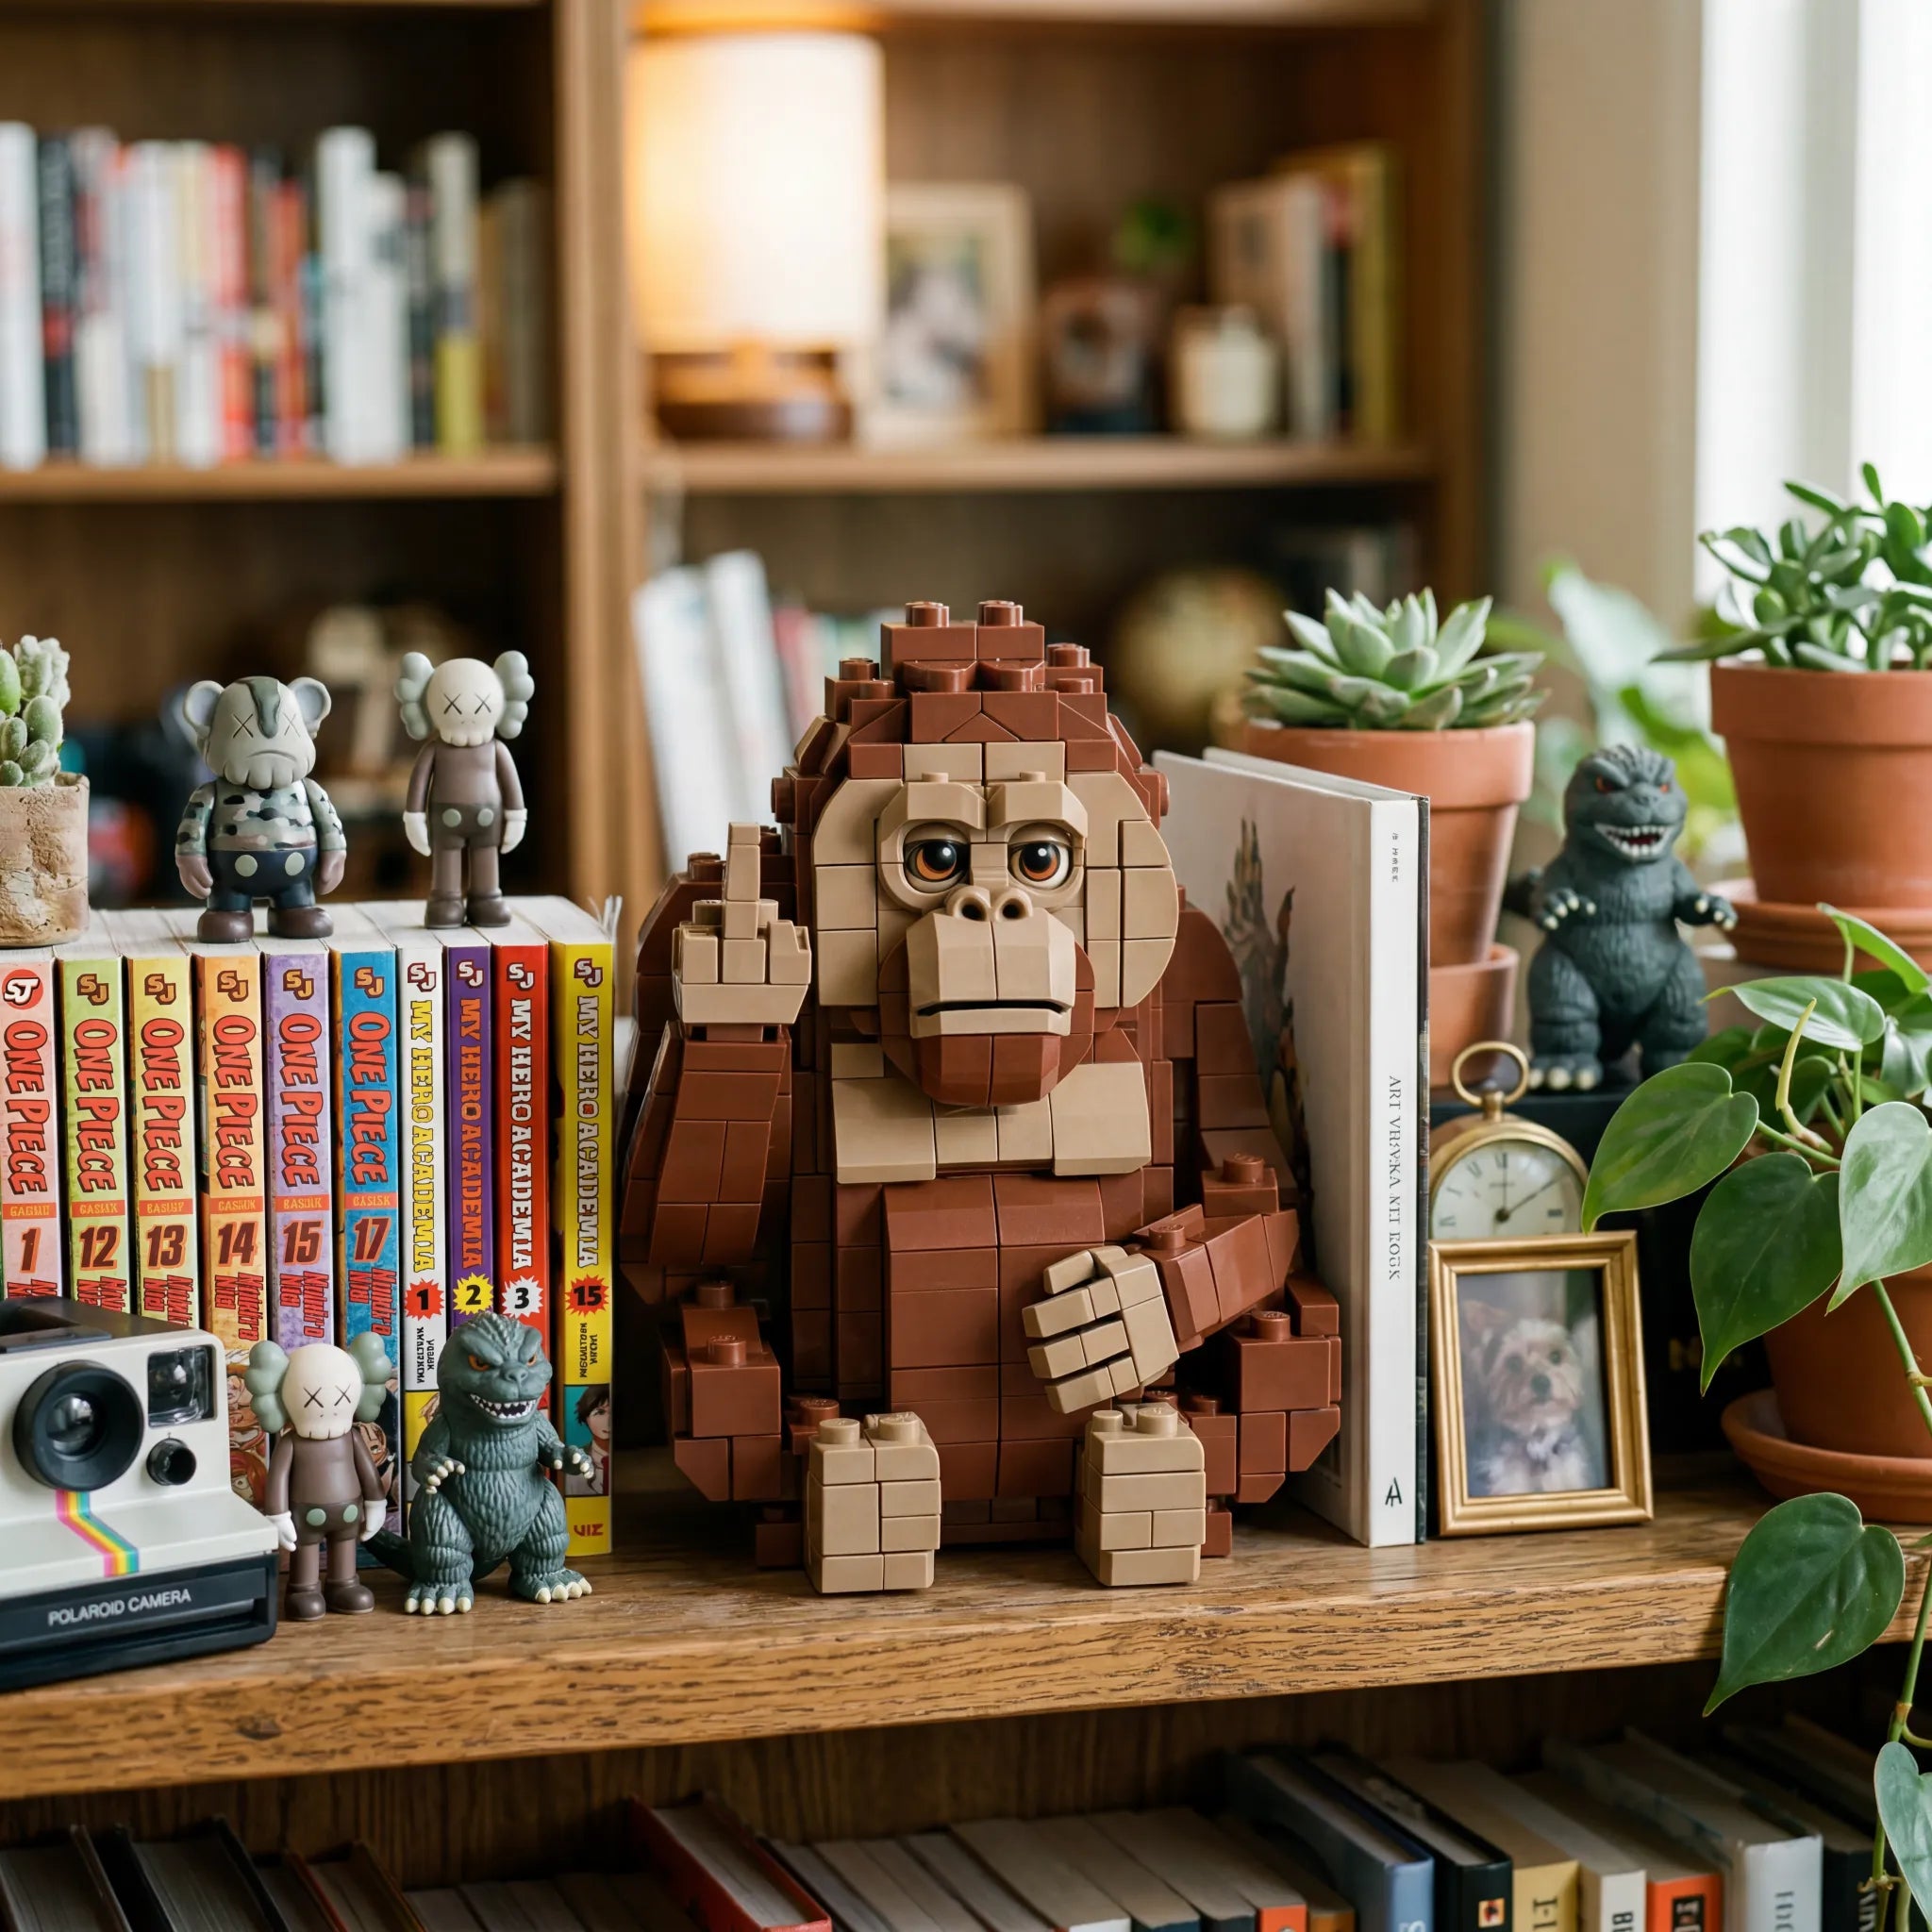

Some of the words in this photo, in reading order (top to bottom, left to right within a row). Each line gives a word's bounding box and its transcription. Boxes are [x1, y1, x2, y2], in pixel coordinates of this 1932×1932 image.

[76, 973, 109, 1006] SJ
[144, 973, 176, 1005] SJ
[217, 970, 249, 1003] SJ
[283, 969, 315, 1001] SJ
[355, 967, 385, 1000] SJ
[407, 962, 436, 992] SJ
[455, 959, 483, 989] SJ
[507, 961, 534, 991] SJ
[575, 958, 603, 988] SJ
[410, 1001, 432, 1041] MY
[460, 1000, 481, 1039] MY
[510, 1000, 531, 1041] MY
[576, 996, 599, 1038] MY
[4, 1020, 49, 1094] ONE
[74, 1019, 117, 1091] ONE
[141, 1018, 184, 1091] ONE
[213, 1015, 257, 1090] ONE
[278, 1013, 322, 1086] ONE
[348, 1011, 391, 1085] ONE
[411, 1047, 433, 1124] HERO
[460, 1044, 481, 1120] HERO
[509, 1044, 532, 1121] HERO
[576, 1042, 599, 1118] HERO
[1389, 1075, 1402, 1109] ART
[6, 1098, 50, 1195] PIECE
[75, 1096, 118, 1191] PIECE
[143, 1096, 185, 1191] PIECE
[215, 1092, 258, 1189] PIECE
[280, 1091, 324, 1188] PIECE
[351, 1090, 391, 1185] PIECE
[411, 1127, 435, 1273] ACADEMIA
[460, 1124, 483, 1269] ACADEMIA
[510, 1124, 532, 1269] ACADEMIA
[577, 1121, 599, 1266] ACADEMIA
[20, 1226, 42, 1274] 1
[79, 1225, 119, 1271] 12
[146, 1224, 188, 1268] 13
[217, 1223, 259, 1267] 14
[283, 1220, 324, 1265] 15
[354, 1218, 391, 1263] 17
[418, 1290, 430, 1311] 1
[466, 1285, 481, 1307] 2
[515, 1288, 529, 1309] 3
[573, 1287, 601, 1306] 15
[47, 1599, 125, 1626] POLAROID
[127, 1589, 192, 1612] CAMERA
